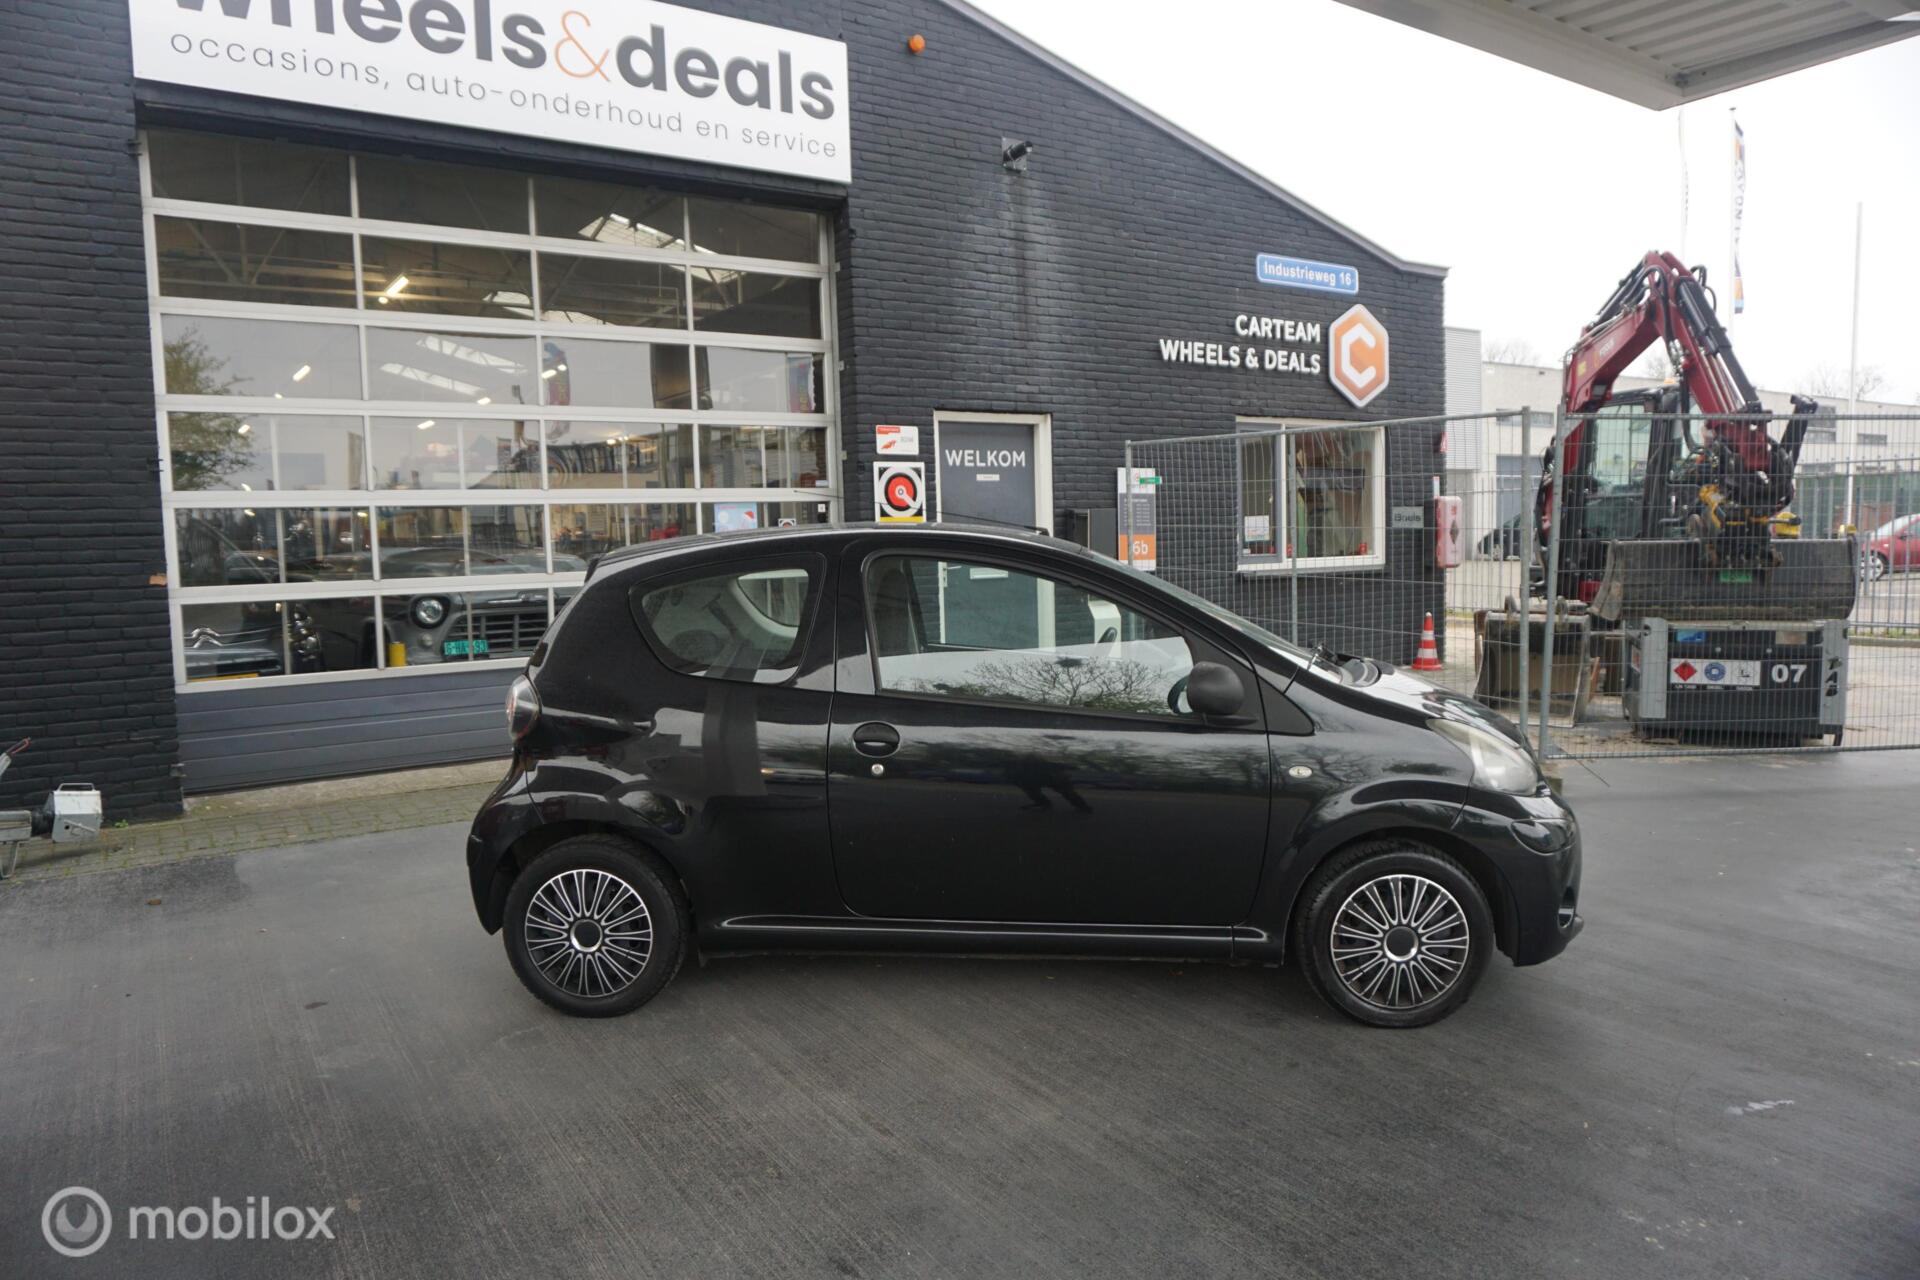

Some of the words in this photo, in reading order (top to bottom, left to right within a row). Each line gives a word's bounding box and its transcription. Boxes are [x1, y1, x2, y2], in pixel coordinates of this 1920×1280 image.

[170, 33, 390, 91] occasions,
[406, 72, 683, 133] auto-onderhoud
[696, 119, 729, 140] en
[742, 132, 837, 158] service
[1263, 261, 1336, 287] Industrieweg
[1340, 272, 1352, 286] 16
[1235, 314, 1321, 343] CARTEAM
[1159, 338, 1241, 368] WHEELS
[1245, 347, 1259, 370] &
[1264, 350, 1321, 375] DEALS
[945, 449, 1027, 468] WELKOM
[1771, 663, 1808, 683] 07
